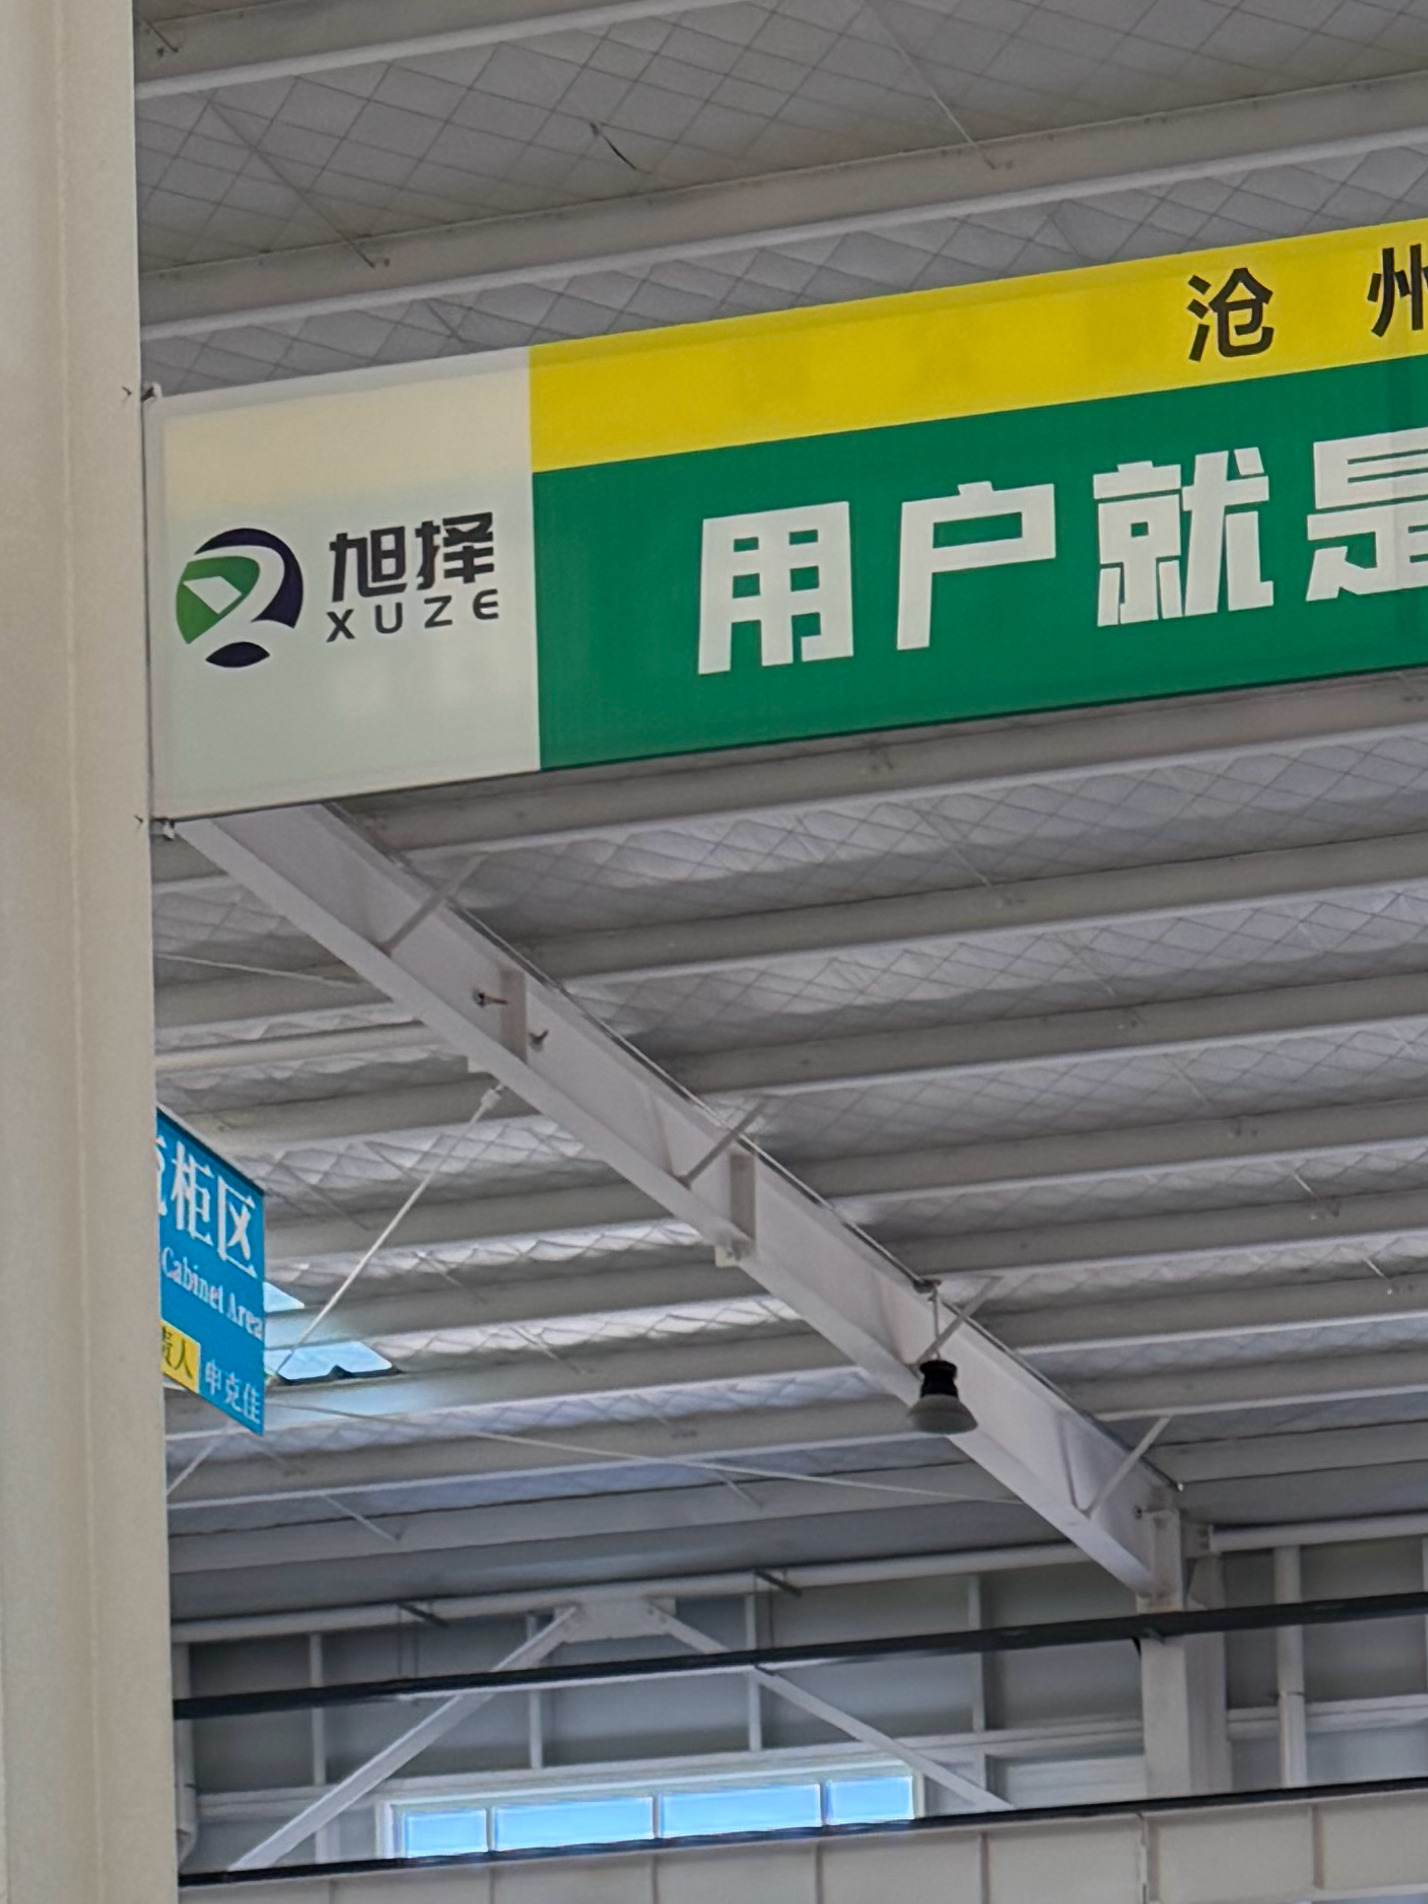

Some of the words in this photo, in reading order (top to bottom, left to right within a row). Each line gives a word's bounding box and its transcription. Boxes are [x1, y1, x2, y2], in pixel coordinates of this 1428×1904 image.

[329, 511, 495, 602] 旭择
[326, 588, 499, 643] XUZE
[161, 1246, 224, 1315] Cabinet
[225, 1292, 264, 1341] Area
